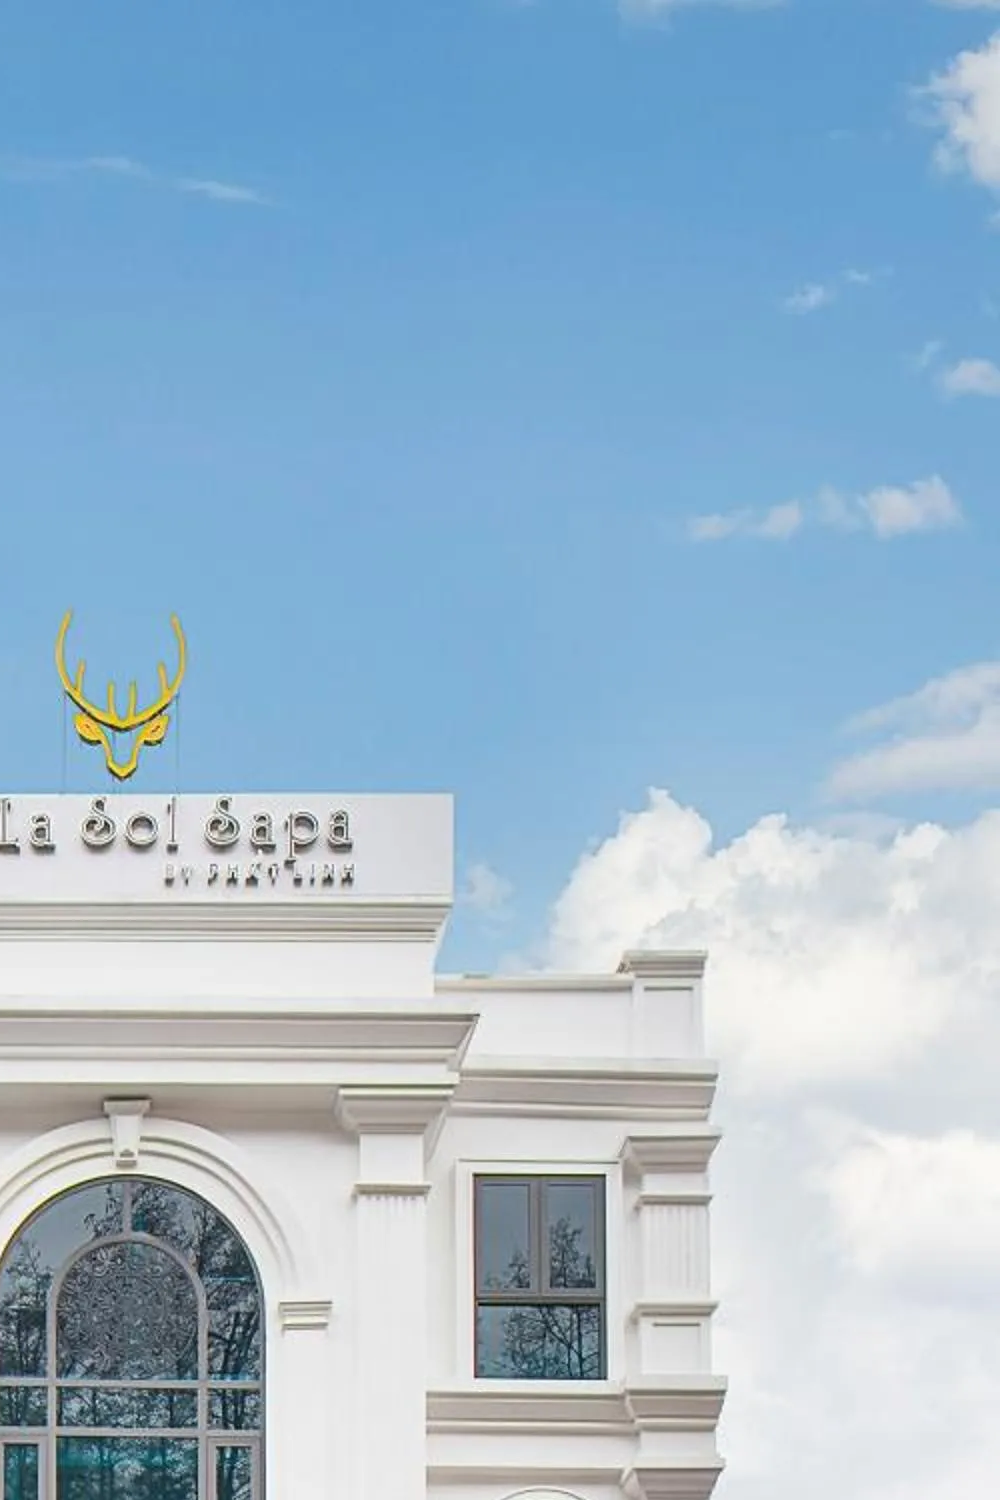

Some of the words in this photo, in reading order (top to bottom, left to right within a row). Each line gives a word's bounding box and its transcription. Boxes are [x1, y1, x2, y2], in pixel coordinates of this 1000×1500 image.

[80, 797, 178, 853] Sol
[204, 796, 353, 868] Sapa
[164, 863, 192, 887] BY
[294, 863, 355, 887] LINH
